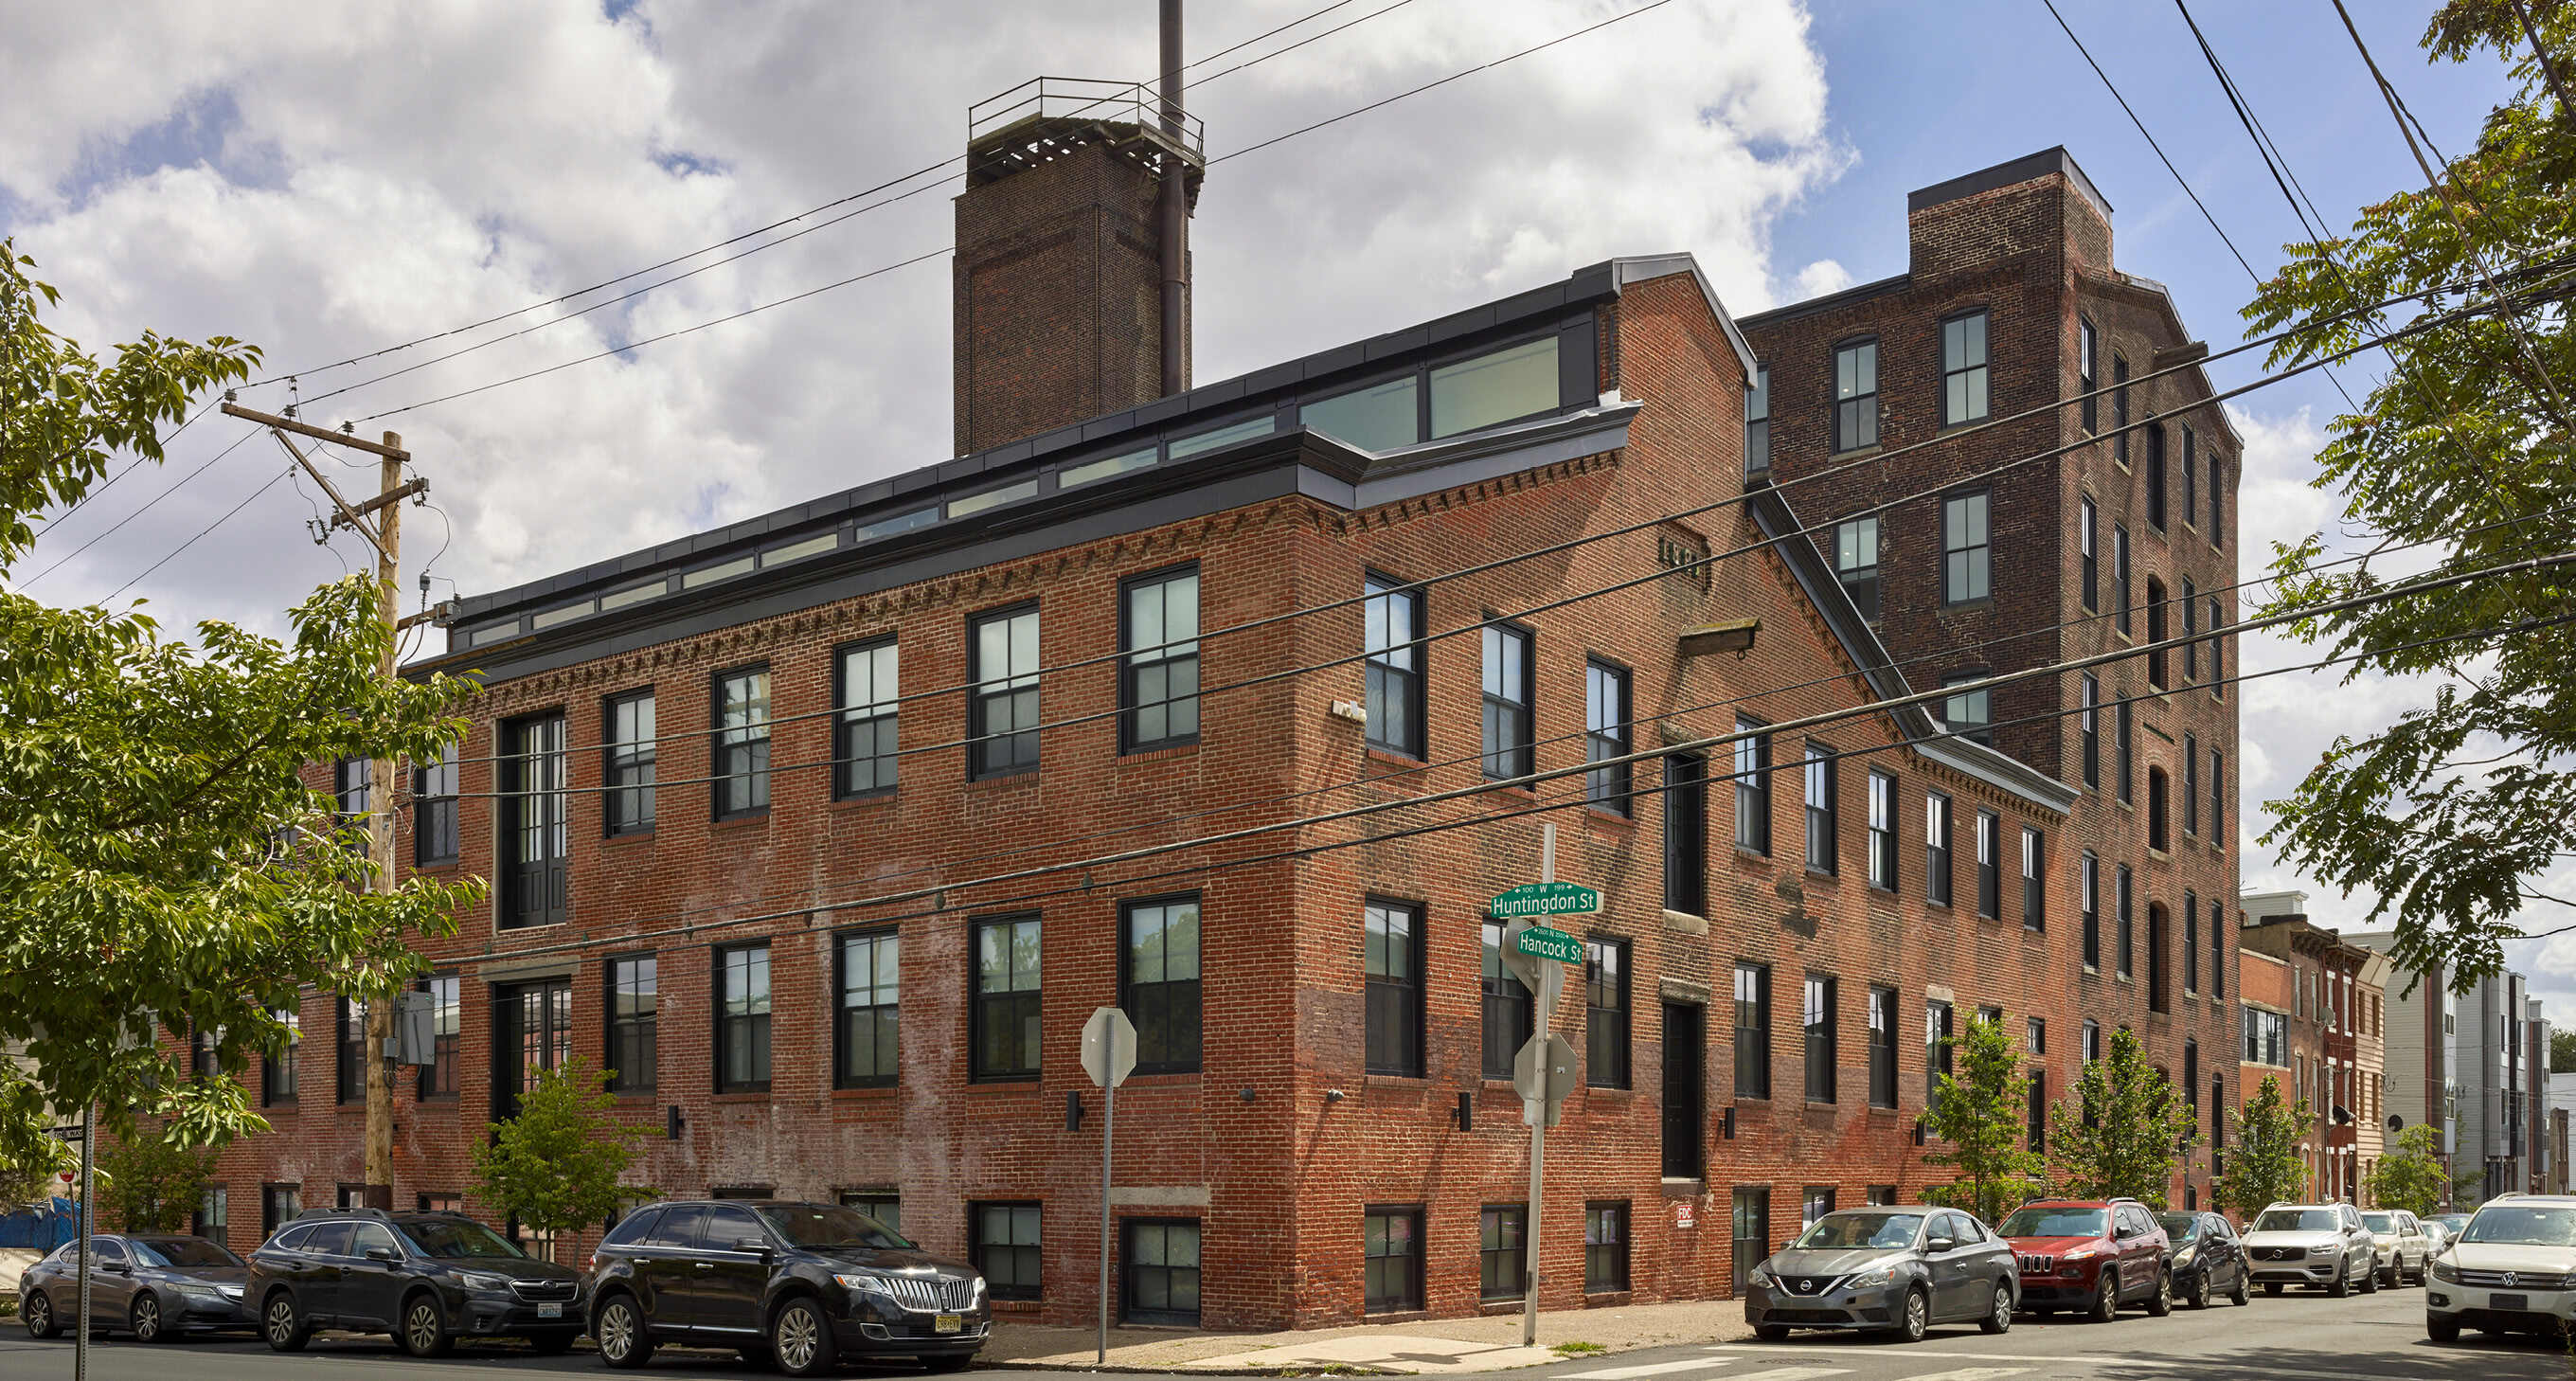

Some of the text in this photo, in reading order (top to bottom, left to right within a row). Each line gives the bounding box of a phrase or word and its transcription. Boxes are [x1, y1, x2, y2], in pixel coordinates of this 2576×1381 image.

[1539, 885, 1547, 893] W
[1494, 893, 1594, 914] Huntingdon St
[1520, 934, 1582, 961] Hancock St
[1678, 1207, 1691, 1219] FDC
